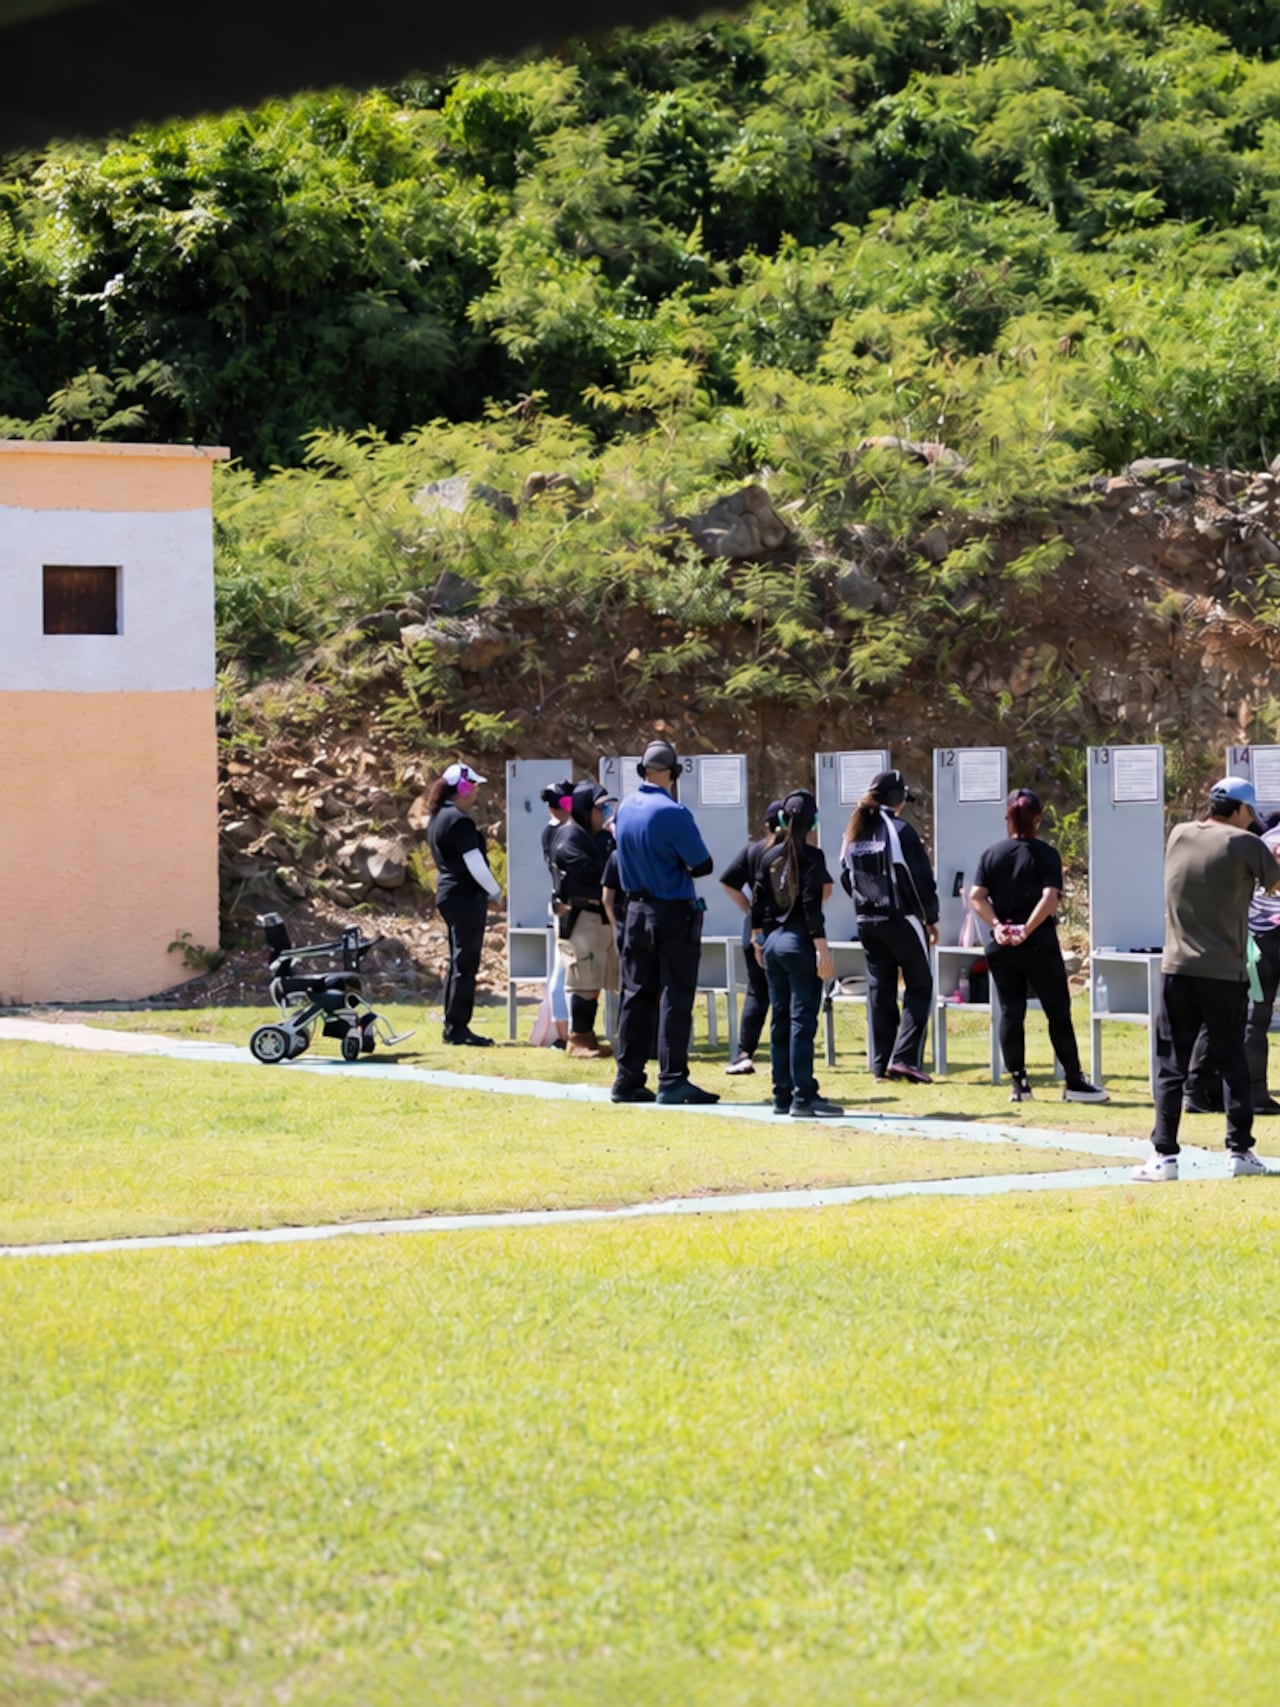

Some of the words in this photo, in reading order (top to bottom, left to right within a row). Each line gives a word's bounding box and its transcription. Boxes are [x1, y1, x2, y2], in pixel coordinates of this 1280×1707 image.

[821, 755, 835, 769] 11
[941, 749, 955, 768] 12
[1094, 748, 1109, 764] 13
[1233, 747, 1249, 765] 14
[511, 763, 518, 778] 1
[605, 757, 616, 774] 2
[684, 757, 694, 774] 3
